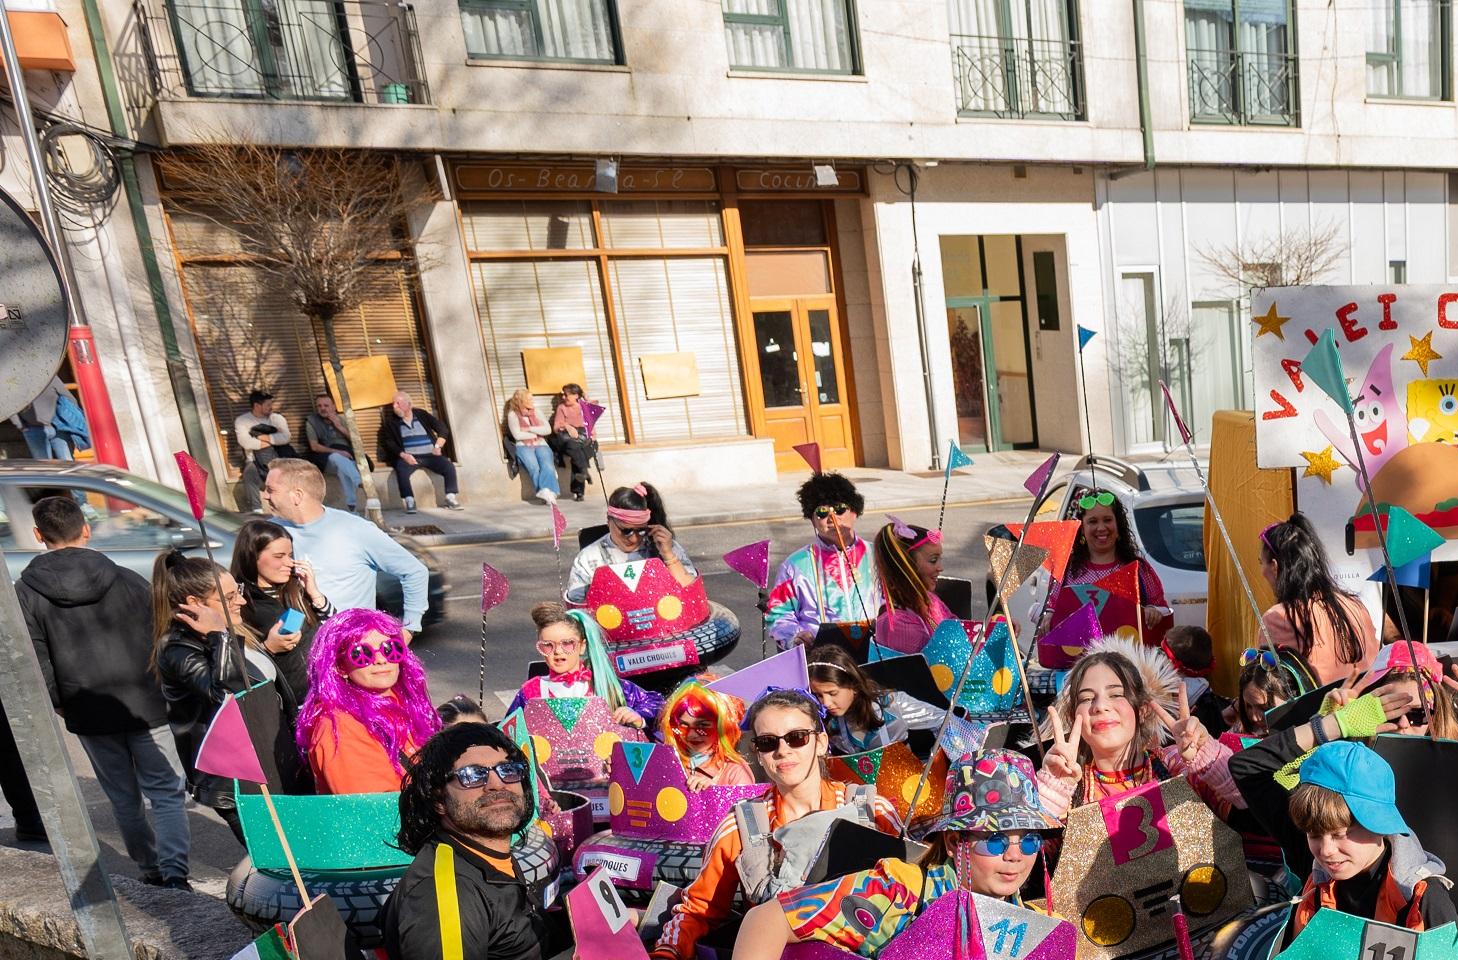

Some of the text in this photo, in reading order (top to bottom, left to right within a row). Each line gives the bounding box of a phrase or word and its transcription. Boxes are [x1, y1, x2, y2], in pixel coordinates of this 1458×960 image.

[624, 564, 637, 580] 4
[627, 655, 646, 667] VALEI
[858, 755, 874, 775] 6
[1115, 795, 1160, 860] 3
[599, 880, 621, 919] 9
[988, 918, 1029, 958] 11
